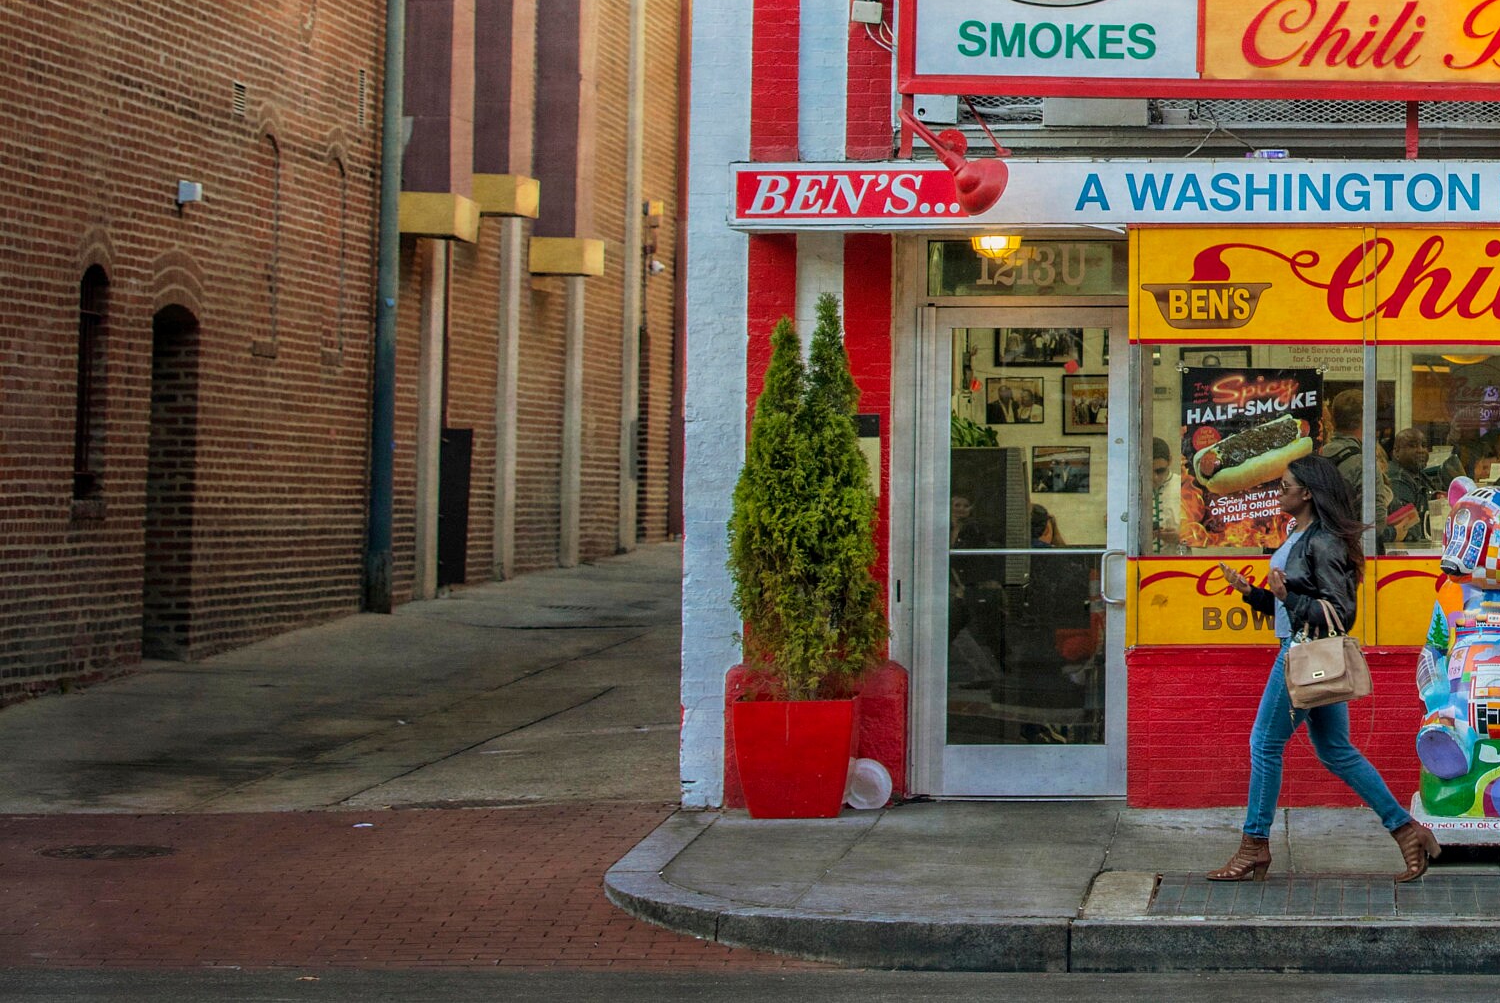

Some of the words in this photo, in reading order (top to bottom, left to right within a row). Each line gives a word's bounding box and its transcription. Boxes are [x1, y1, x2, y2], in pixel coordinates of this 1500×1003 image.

[957, 20, 1157, 60] SMOKES
[1074, 173, 1111, 212] A
[1125, 173, 1482, 213] WASHINGTON
[1058, 243, 1088, 286] U
[1168, 288, 1251, 321] BEN'S
[1288, 346, 1309, 354] Table
[1311, 346, 1341, 354] Service
[1343, 346, 1363, 354] Avail
[1292, 355, 1304, 363] for
[1212, 374, 1299, 407] Spicy
[1187, 391, 1317, 424] HALF-SMOKE
[1209, 499, 1216, 507] A
[1217, 496, 1244, 508] Spicy
[1245, 491, 1262, 501] NEW
[1211, 505, 1226, 516] ON
[1227, 501, 1247, 512] OUR
[1249, 498, 1281, 510] ORIGIN
[1223, 507, 1281, 523] HALF-SMOKE
[1202, 606, 1275, 631] BOW
[1477, 822, 1490, 830] OR
